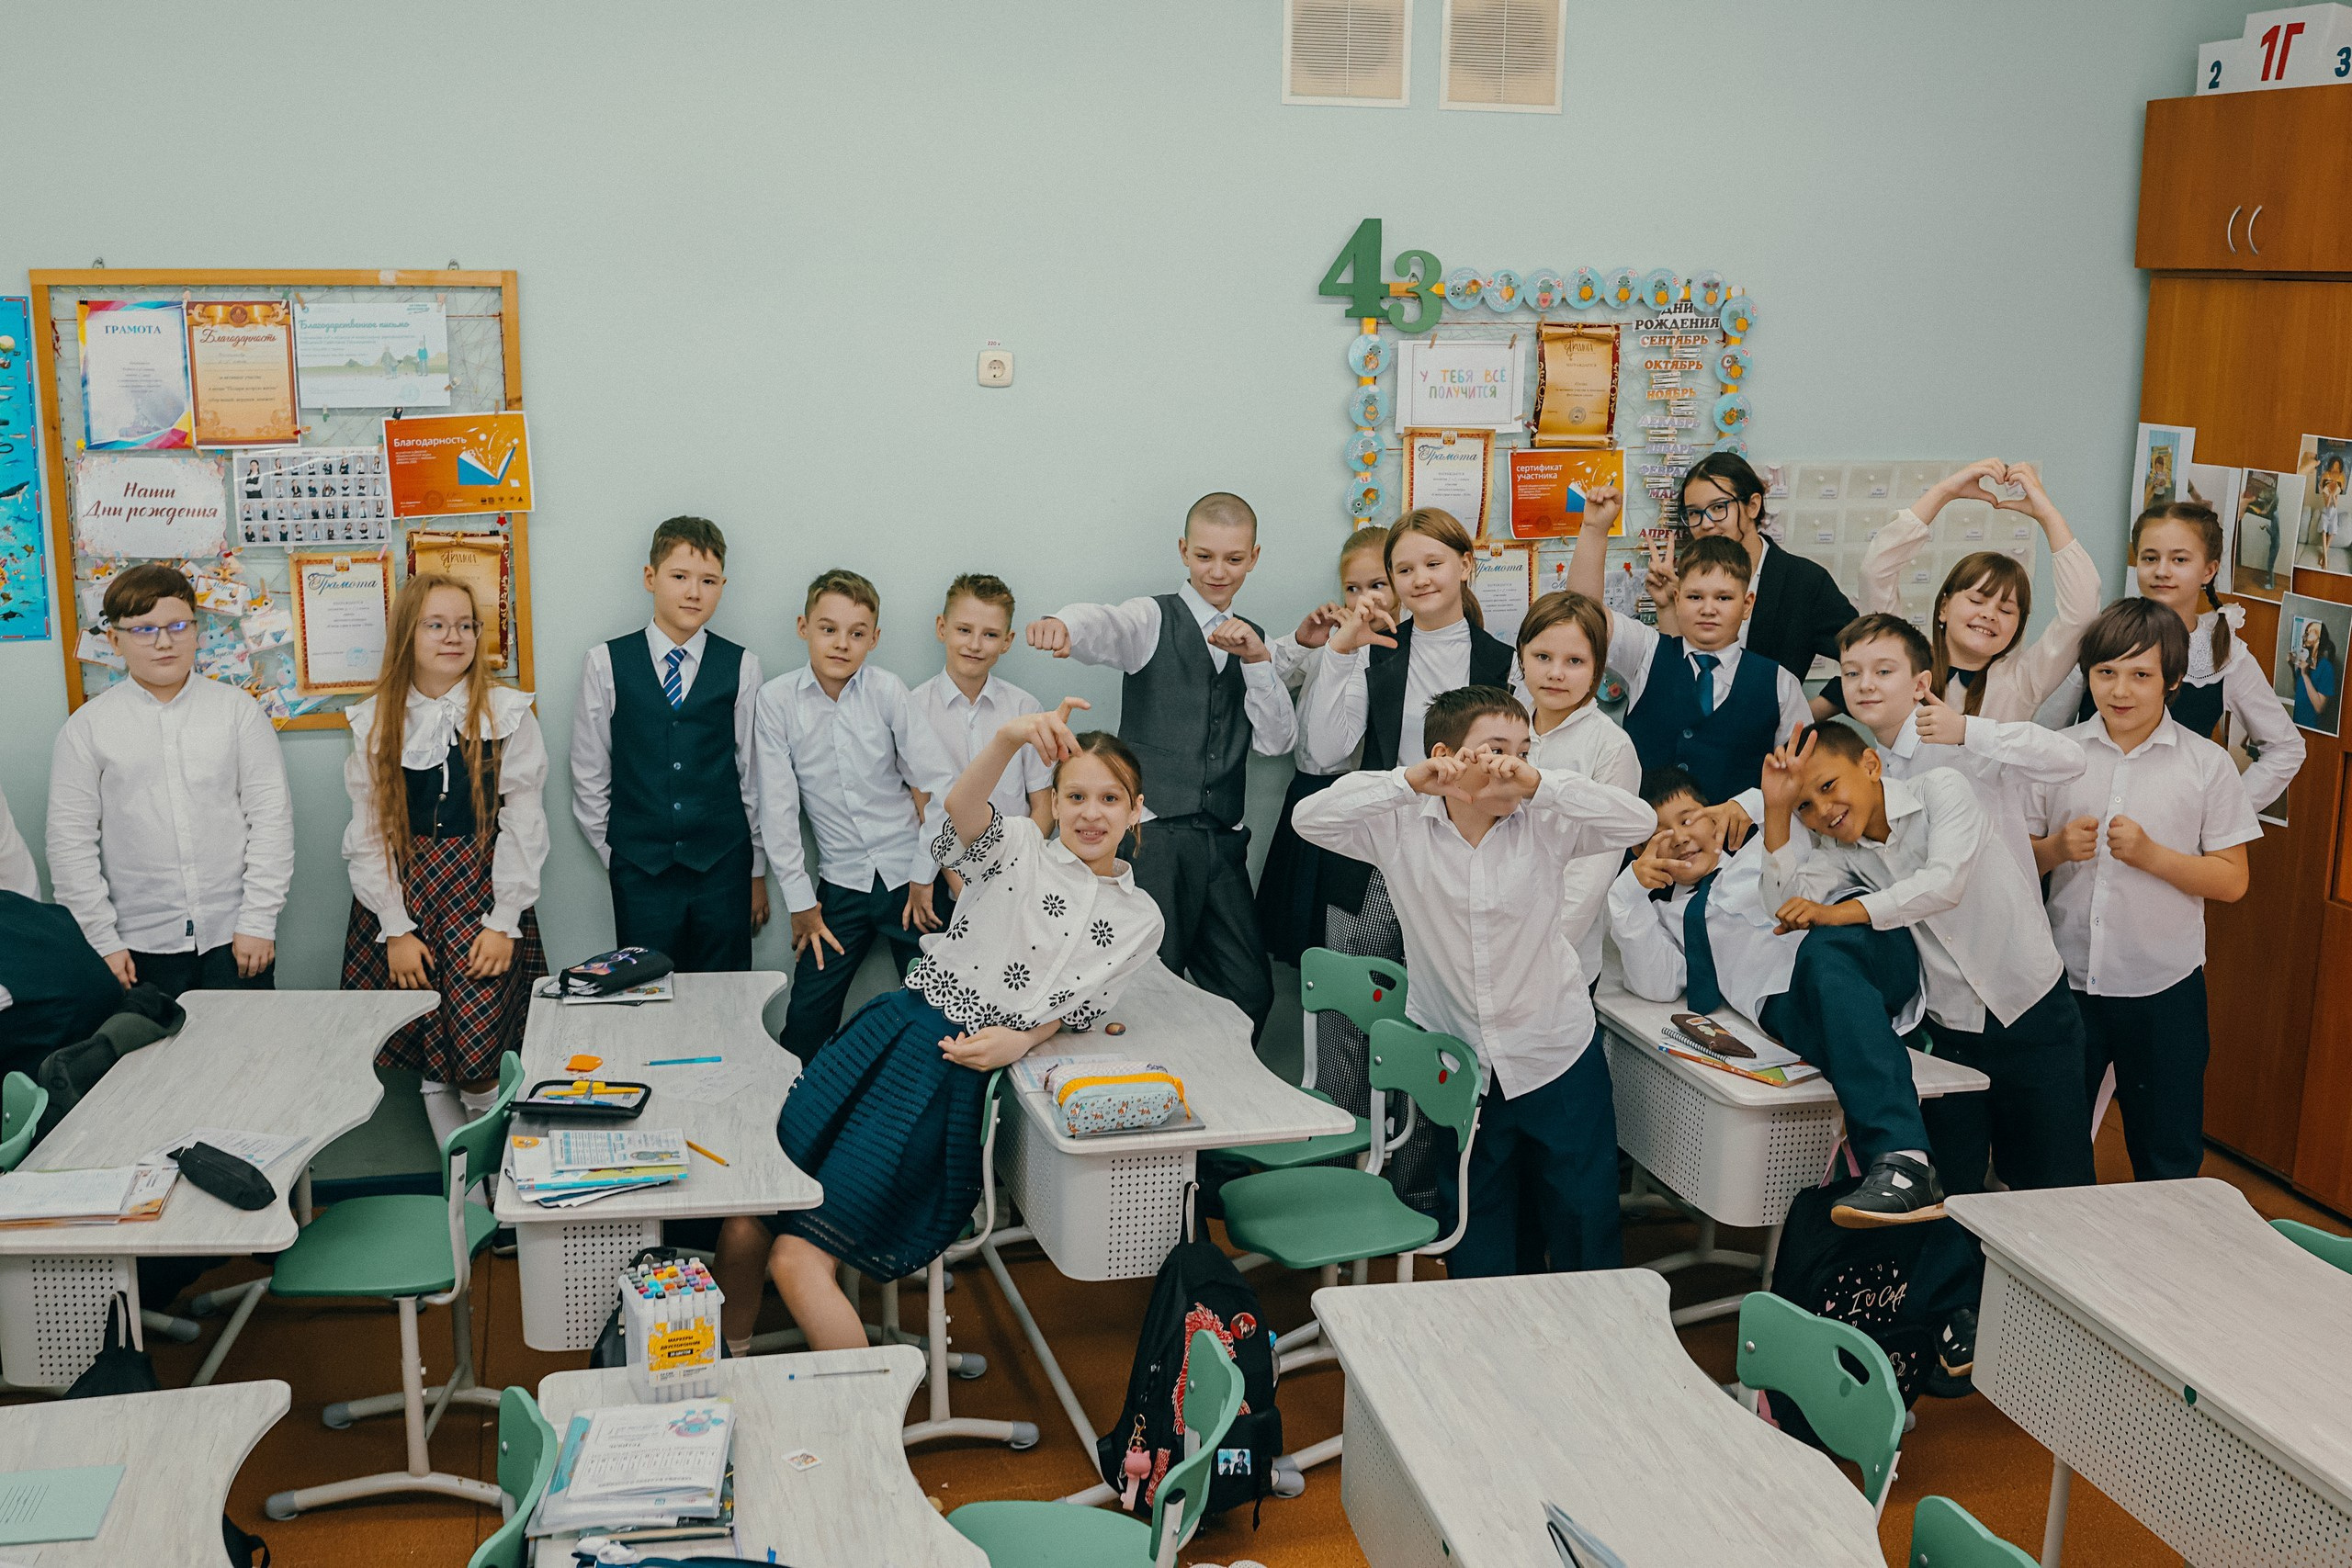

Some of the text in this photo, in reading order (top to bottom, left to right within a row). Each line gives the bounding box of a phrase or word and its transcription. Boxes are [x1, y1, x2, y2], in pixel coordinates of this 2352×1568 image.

[2334, 46, 2351, 77] 3
[2208, 60, 2222, 89] 2
[105, 325, 162, 334] ГРАМОТА
[298, 318, 379, 333] Благодарственное
[1634, 318, 1720, 330] РОЖДЕНИЯ
[199, 329, 277, 347] Благодарность
[1640, 334, 1709, 346] СЕНТЯБРЬ
[1645, 359, 1703, 370] ОКТЯБРЬ
[1420, 370, 1428, 382] У
[1441, 369, 1473, 383] ТЕБЯ
[1430, 385, 1497, 399] ПОЛУЧИТСЯ
[1646, 388, 1696, 400] НОЯБРЬ
[1639, 416, 1701, 428] ДЕКАБРЬ
[393, 436, 467, 447] Благодарность
[1418, 445, 1477, 466] Грамота
[1646, 444, 1695, 454] ЯНВАРЬ
[1516, 464, 1563, 473] сертификат
[1517, 472, 1558, 481] участника
[123, 481, 175, 499] Наши
[1649, 489, 1678, 499] МАР
[83, 500, 218, 525] Дни рождения
[307, 572, 378, 595] Грамота
[1848, 1288, 1871, 1315] I
